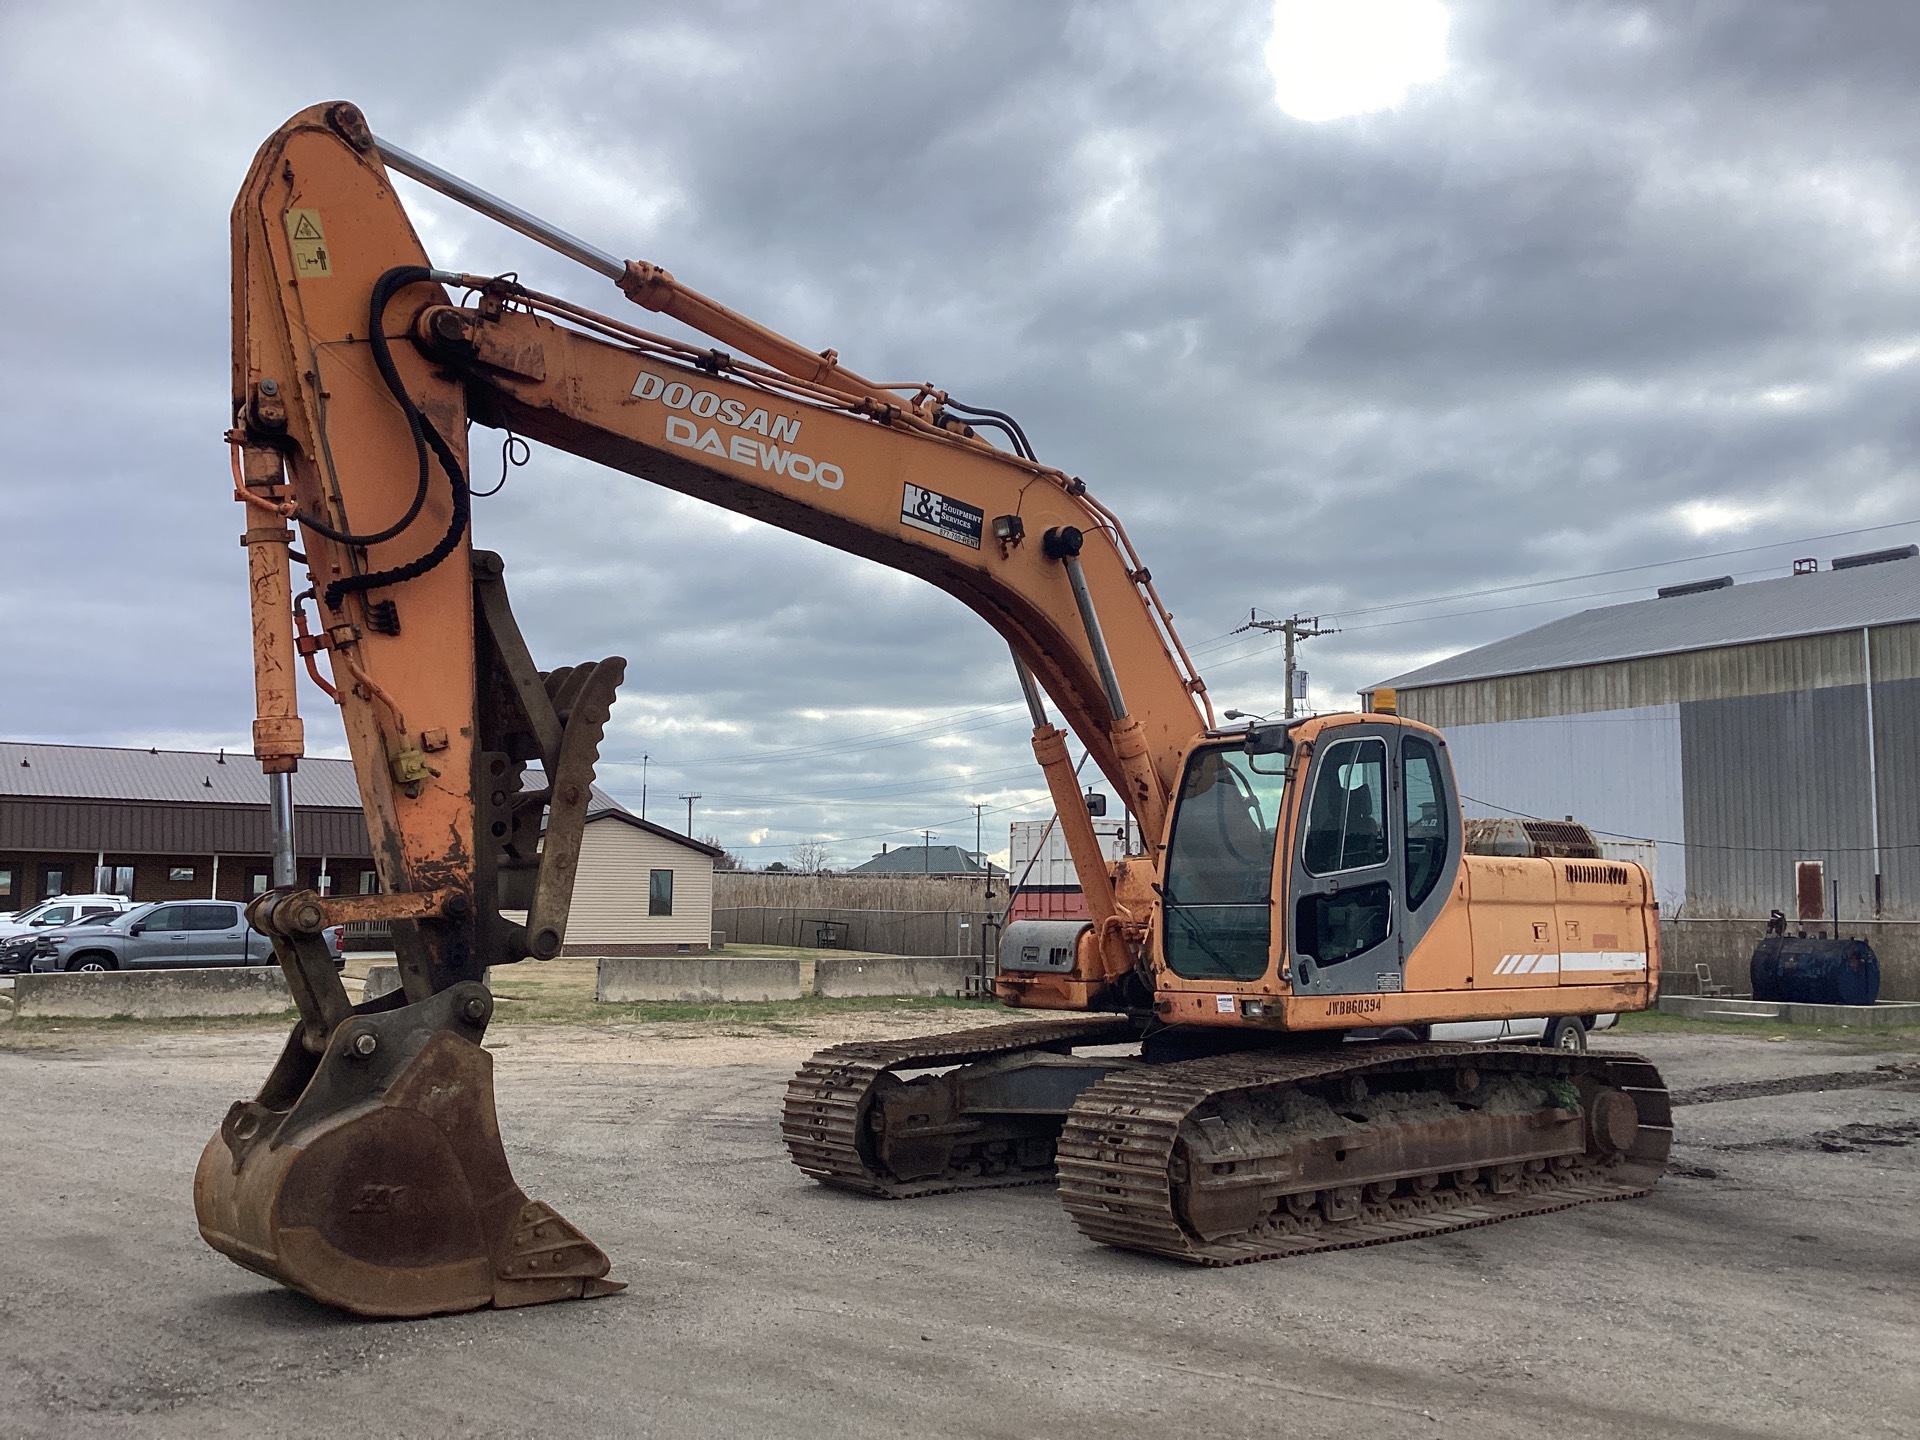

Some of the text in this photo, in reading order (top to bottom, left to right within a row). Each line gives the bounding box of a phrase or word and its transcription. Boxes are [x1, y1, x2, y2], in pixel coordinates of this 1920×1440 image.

[631, 371, 802, 444] DOOSAN
[665, 415, 845, 490] DAEWOO
[903, 483, 943, 523] H&E
[942, 502, 982, 523] EQUIPMENT
